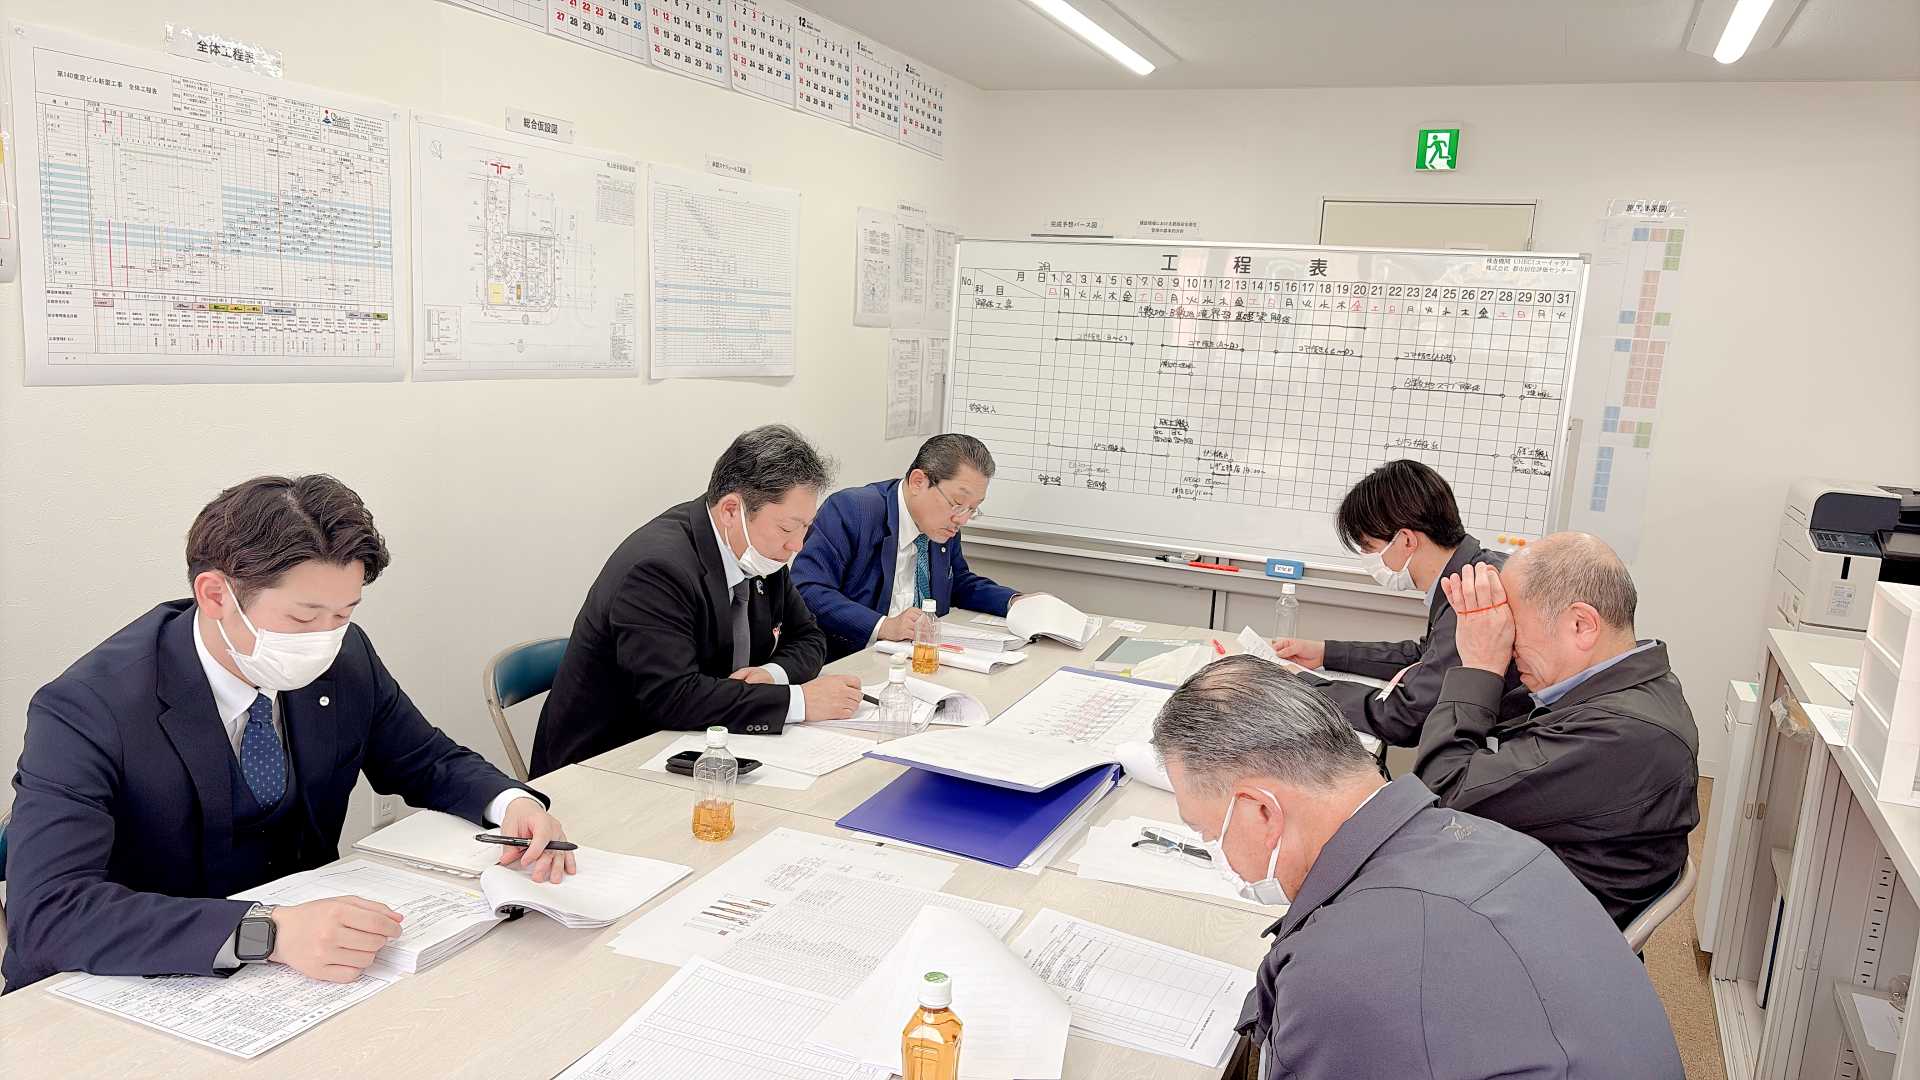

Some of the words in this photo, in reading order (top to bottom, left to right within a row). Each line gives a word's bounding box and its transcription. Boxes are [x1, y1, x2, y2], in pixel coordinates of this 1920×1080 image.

[634, 2, 641, 11] 19
[582, 2, 591, 12] 22
[595, 7, 604, 16] 23
[608, 12, 616, 21] 24
[621, 16, 629, 26] 25
[634, 21, 642, 30] 26
[716, 15, 722, 23] 10
[798, 16, 806, 28] 12
[556, 12, 565, 21] 27
[570, 17, 578, 26] 28
[582, 22, 591, 31] 29
[596, 26, 604, 36] 30
[652, 8, 658, 16] 11
[663, 12, 670, 20] 12
[674, 16, 680, 24] 13
[684, 20, 691, 29] 14
[695, 24, 702, 33] 15
[706, 28, 712, 36] 16
[716, 32, 722, 40] 17
[653, 26, 660, 35] 18
[663, 30, 670, 39] 19
[674, 34, 680, 42] 20
[684, 38, 691, 46] 21
[694, 42, 702, 50] 22
[705, 45, 712, 54] 23
[716, 48, 722, 56] 24
[750, 28, 756, 36] 10
[769, 35, 775, 43] 12
[197, 40, 255, 64] 全体工程表
[750, 44, 756, 52] 17
[857, 41, 860, 50] 1
[654, 44, 660, 53] 25
[664, 48, 670, 57] 26
[674, 52, 680, 60] 27
[684, 55, 691, 64] 28
[694, 59, 702, 67] 29
[705, 62, 712, 70] 30
[740, 56, 747, 65] 23
[750, 60, 756, 68] 24
[758, 64, 764, 72] 25
[906, 64, 910, 72] 2
[740, 73, 747, 81] 30
[523, 117, 558, 135] 総合仮設図
[1161, 254, 1178, 271] 工
[1233, 256, 1252, 274] 程
[1309, 258, 1329, 278] 表
[961, 276, 973, 286] No.
[1016, 272, 1024, 281] 月
[1038, 273, 1046, 282] 日
[976, 285, 984, 294] 科
[996, 286, 1004, 295] 目
[1052, 274, 1056, 282] 1
[1066, 274, 1072, 283] 2
[1080, 275, 1087, 283] 3
[1096, 275, 1102, 284] 4
[1111, 276, 1117, 285] 5
[1126, 276, 1132, 285] 6
[1142, 277, 1148, 286] 7
[1157, 277, 1163, 287] 8
[1173, 278, 1179, 287] 9
[1187, 278, 1198, 288] 10
[1203, 279, 1213, 288] 11
[1220, 280, 1230, 289] 12
[1236, 280, 1247, 290] 13
[1252, 280, 1263, 291] 14
[1268, 281, 1280, 292] 15
[1286, 282, 1297, 292] 16
[1302, 283, 1315, 293] 17
[1319, 283, 1332, 294] 18
[1337, 284, 1349, 294] 19
[1353, 285, 1367, 295] 20
[1371, 285, 1383, 296] 21
[1388, 286, 1402, 297] 22
[1406, 287, 1420, 297] 23
[1424, 288, 1438, 298] 24
[1442, 289, 1456, 299] 25
[1461, 290, 1475, 300] 26
[1480, 290, 1494, 301] 27
[1498, 291, 1513, 302] 28
[1518, 292, 1532, 302] 29
[1537, 292, 1551, 303] 30
[1556, 293, 1570, 304] 31
[1049, 287, 1057, 296] 日
[1064, 288, 1070, 298] 月
[1079, 289, 1087, 298] 火
[1093, 290, 1102, 299] 水
[1108, 291, 1117, 300] 木
[1122, 291, 1133, 302] 金
[1140, 292, 1147, 301] 土
[1155, 292, 1163, 301] 日
[1171, 294, 1178, 303] 月
[1186, 296, 1199, 304] 火
[1202, 296, 1213, 304] 水
[1219, 297, 1228, 305] 木
[1235, 297, 1245, 307] 金
[1268, 299, 1275, 308] 日
[1286, 299, 1293, 307] 月
[1302, 300, 1312, 308] 火
[1319, 301, 1330, 309] 水
[1336, 301, 1347, 310] 木
[1352, 300, 1362, 311] 金
[1425, 306, 1433, 314] 火
[1461, 308, 1470, 316] 木
[1478, 307, 1489, 319] 金
[1517, 310, 1526, 319] 日
[1538, 310, 1545, 319] 月
[1556, 311, 1566, 319] 火
